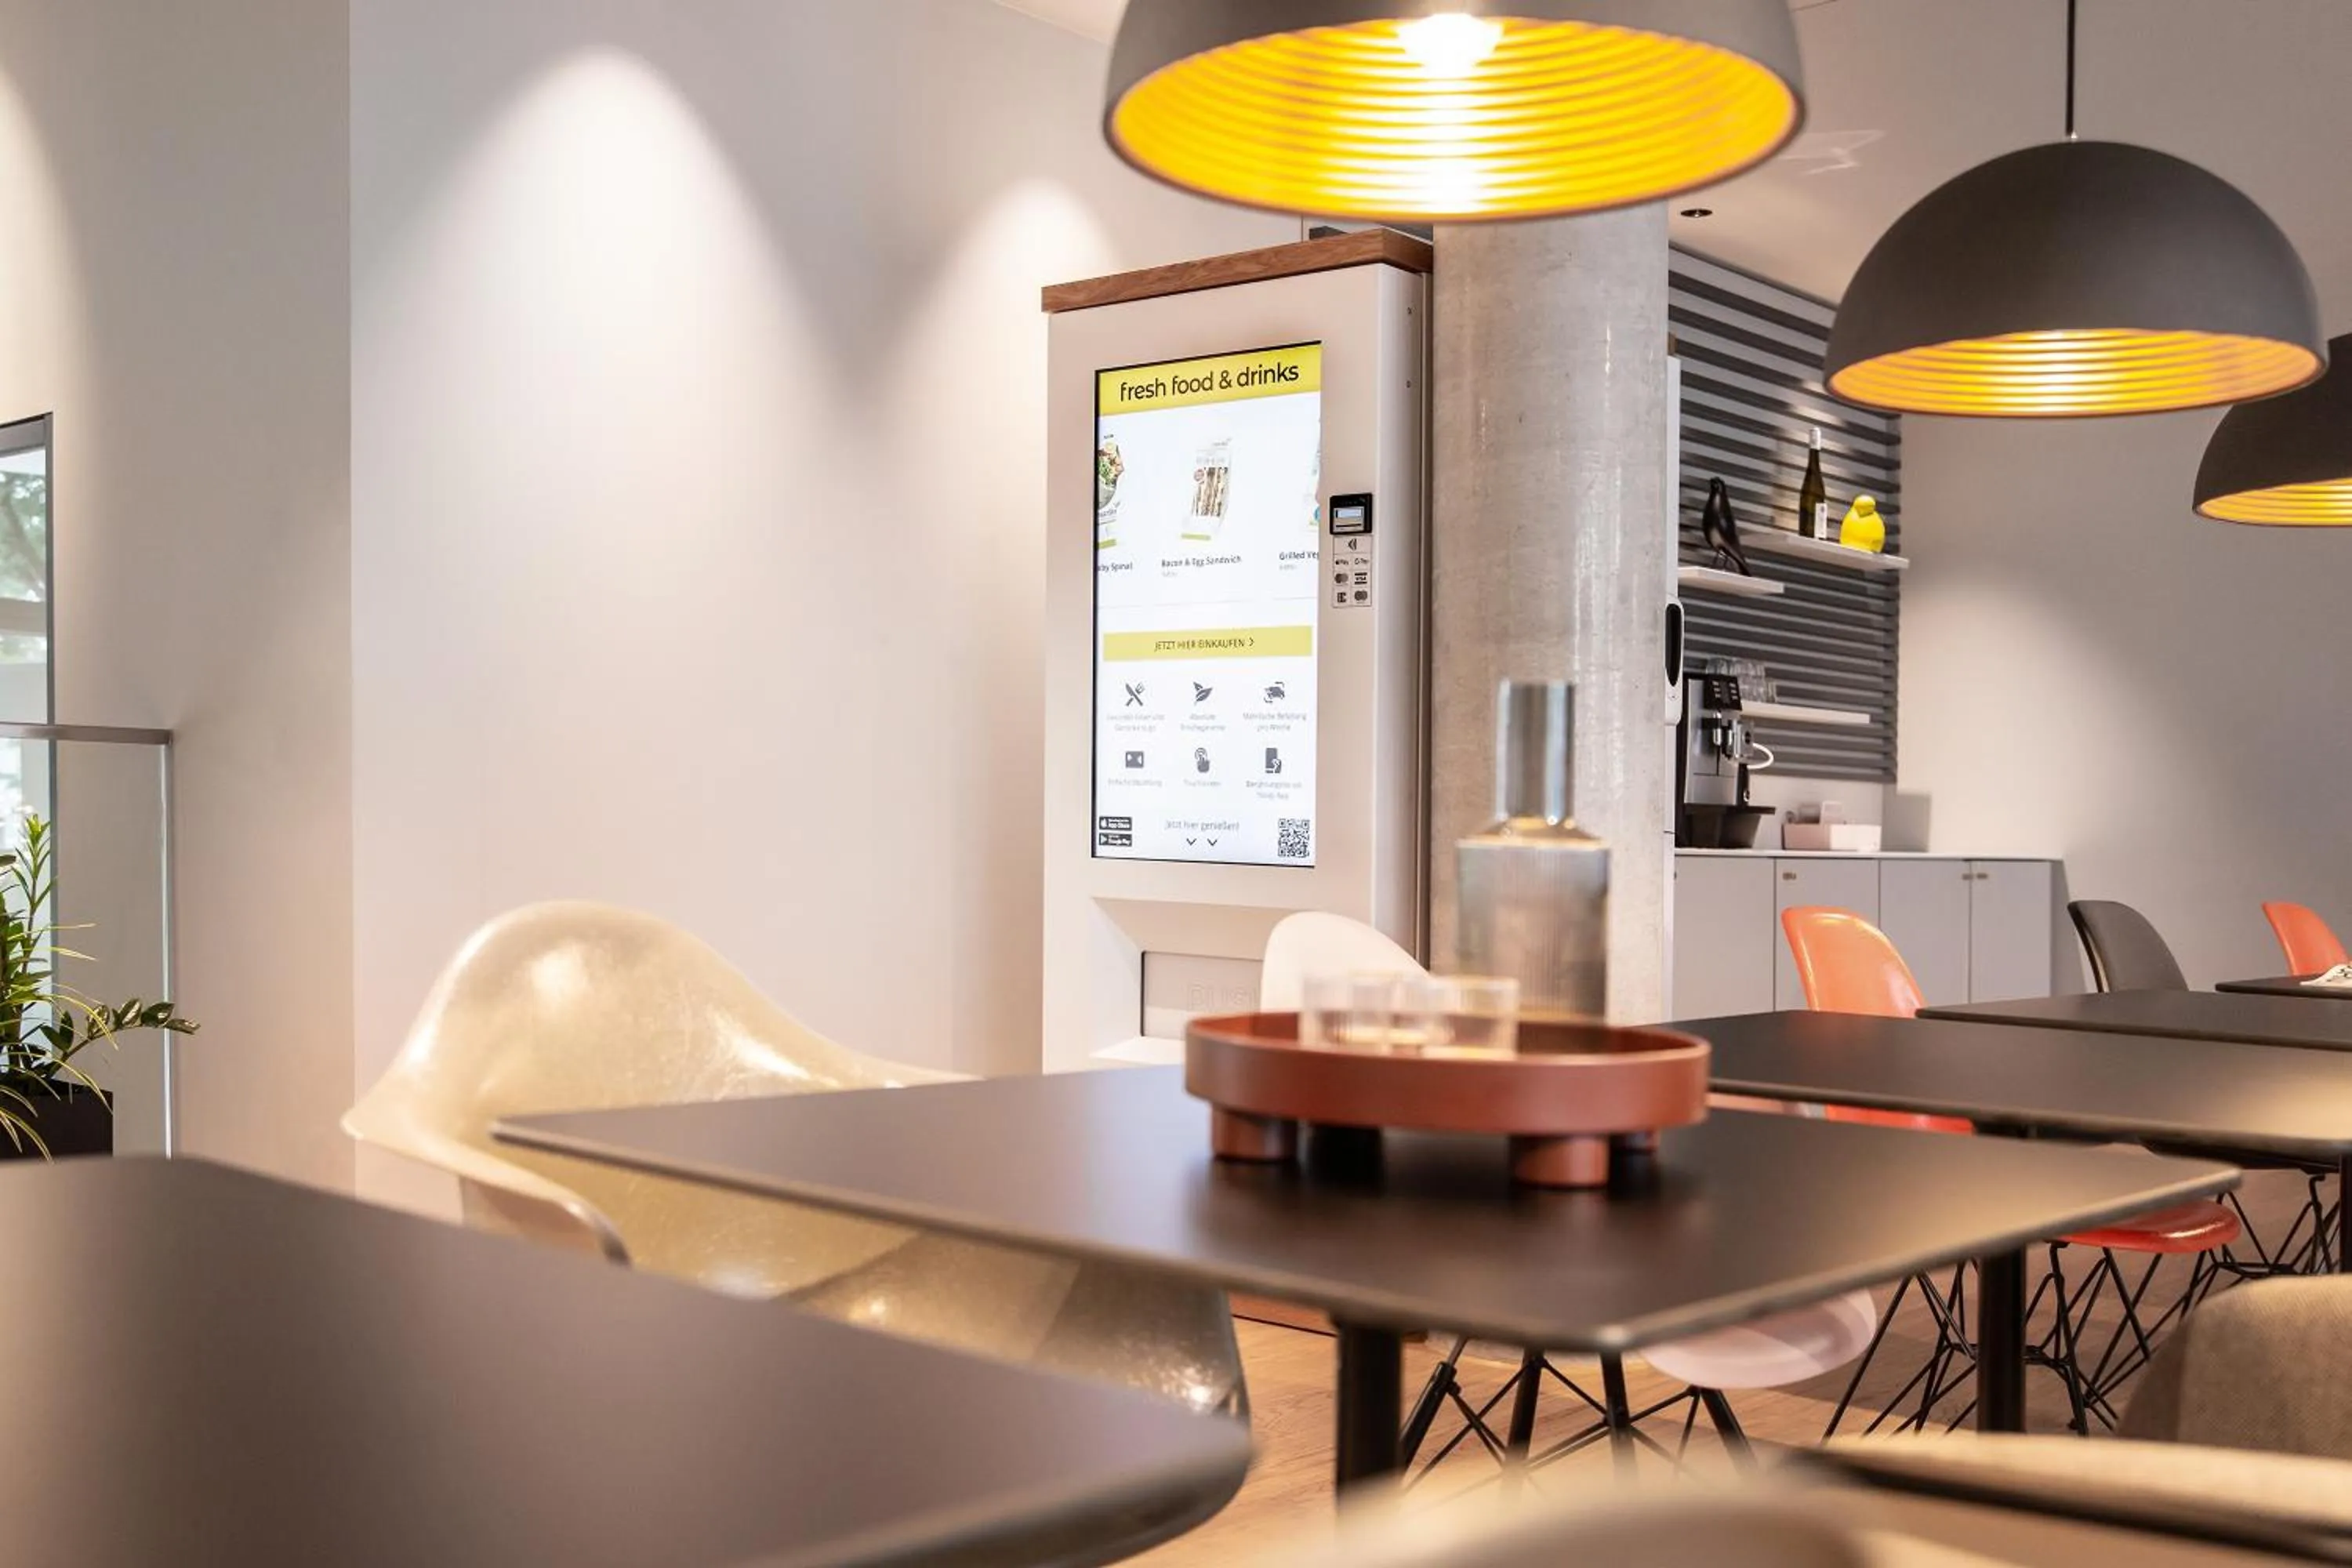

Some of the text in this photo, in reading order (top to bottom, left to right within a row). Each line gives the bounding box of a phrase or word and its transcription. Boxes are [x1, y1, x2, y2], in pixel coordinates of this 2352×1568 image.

[1120, 361, 1300, 402] fresh food & drinks
[1161, 558, 1183, 568] Bacon
[1205, 554, 1242, 565] Sandwich
[1279, 550, 1305, 561] Grilled
[1154, 638, 1245, 652] JETZT HIER EINKAUFEN
